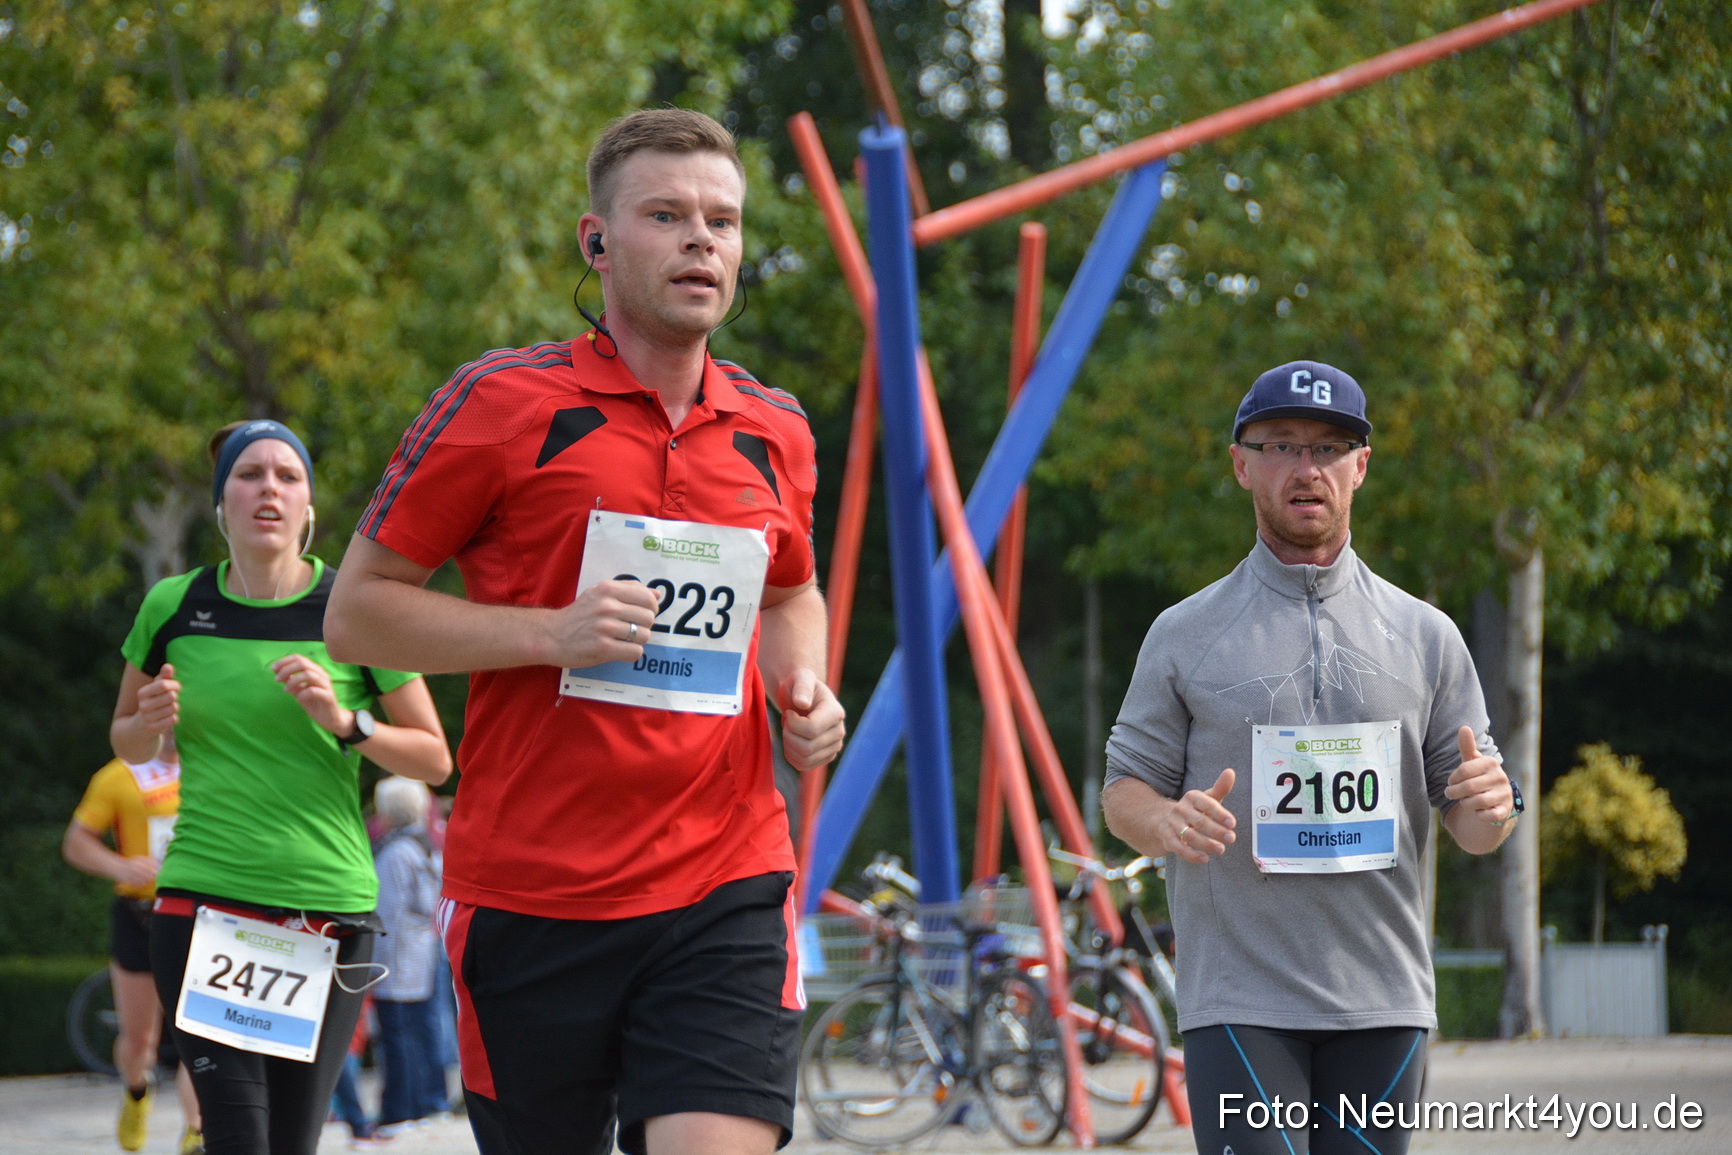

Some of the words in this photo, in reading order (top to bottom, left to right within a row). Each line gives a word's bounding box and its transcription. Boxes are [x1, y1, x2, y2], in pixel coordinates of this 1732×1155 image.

[1290, 369, 1332, 406] CG
[662, 538, 720, 559] BOCK
[611, 573, 736, 640] 223
[633, 653, 693, 677] Dennis
[1311, 738, 1362, 752] BOCK
[1275, 769, 1379, 815] 2160
[1260, 810, 1267, 818] D
[1297, 831, 1361, 847] Christian
[247, 932, 296, 953] BOCK
[206, 953, 309, 1007] 2477
[224, 1008, 273, 1031] Marina
